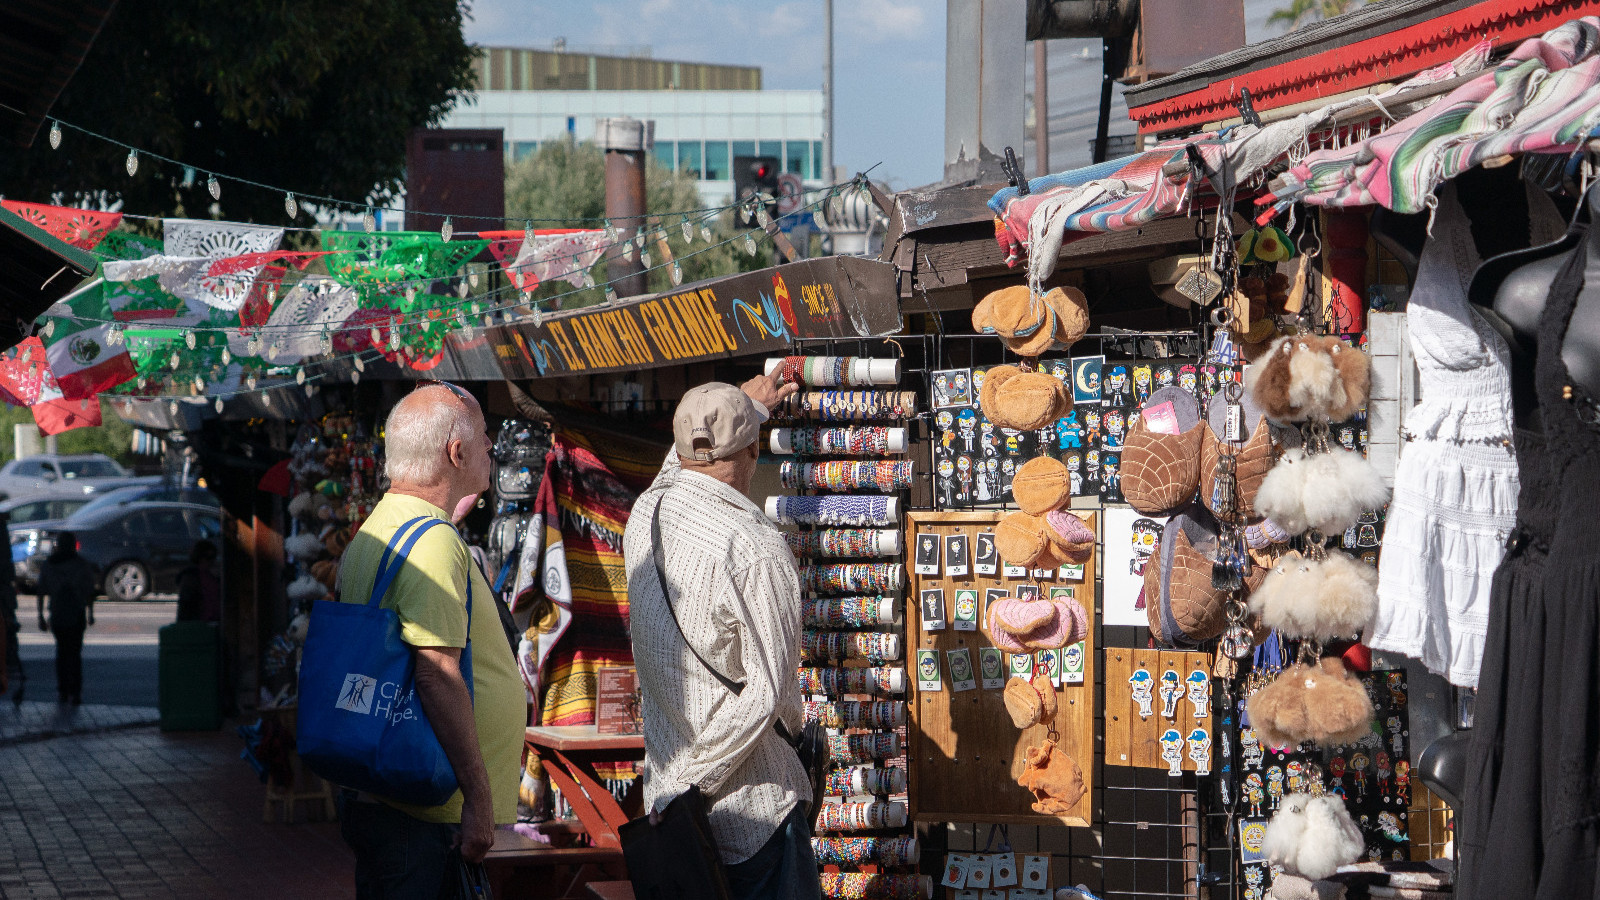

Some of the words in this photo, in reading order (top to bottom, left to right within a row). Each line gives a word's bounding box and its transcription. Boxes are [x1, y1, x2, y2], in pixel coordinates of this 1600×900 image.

[802, 284, 829, 316] SINCE
[547, 322, 585, 371] EL
[570, 308, 655, 369] RANCHO
[640, 289, 738, 361] GRANDE
